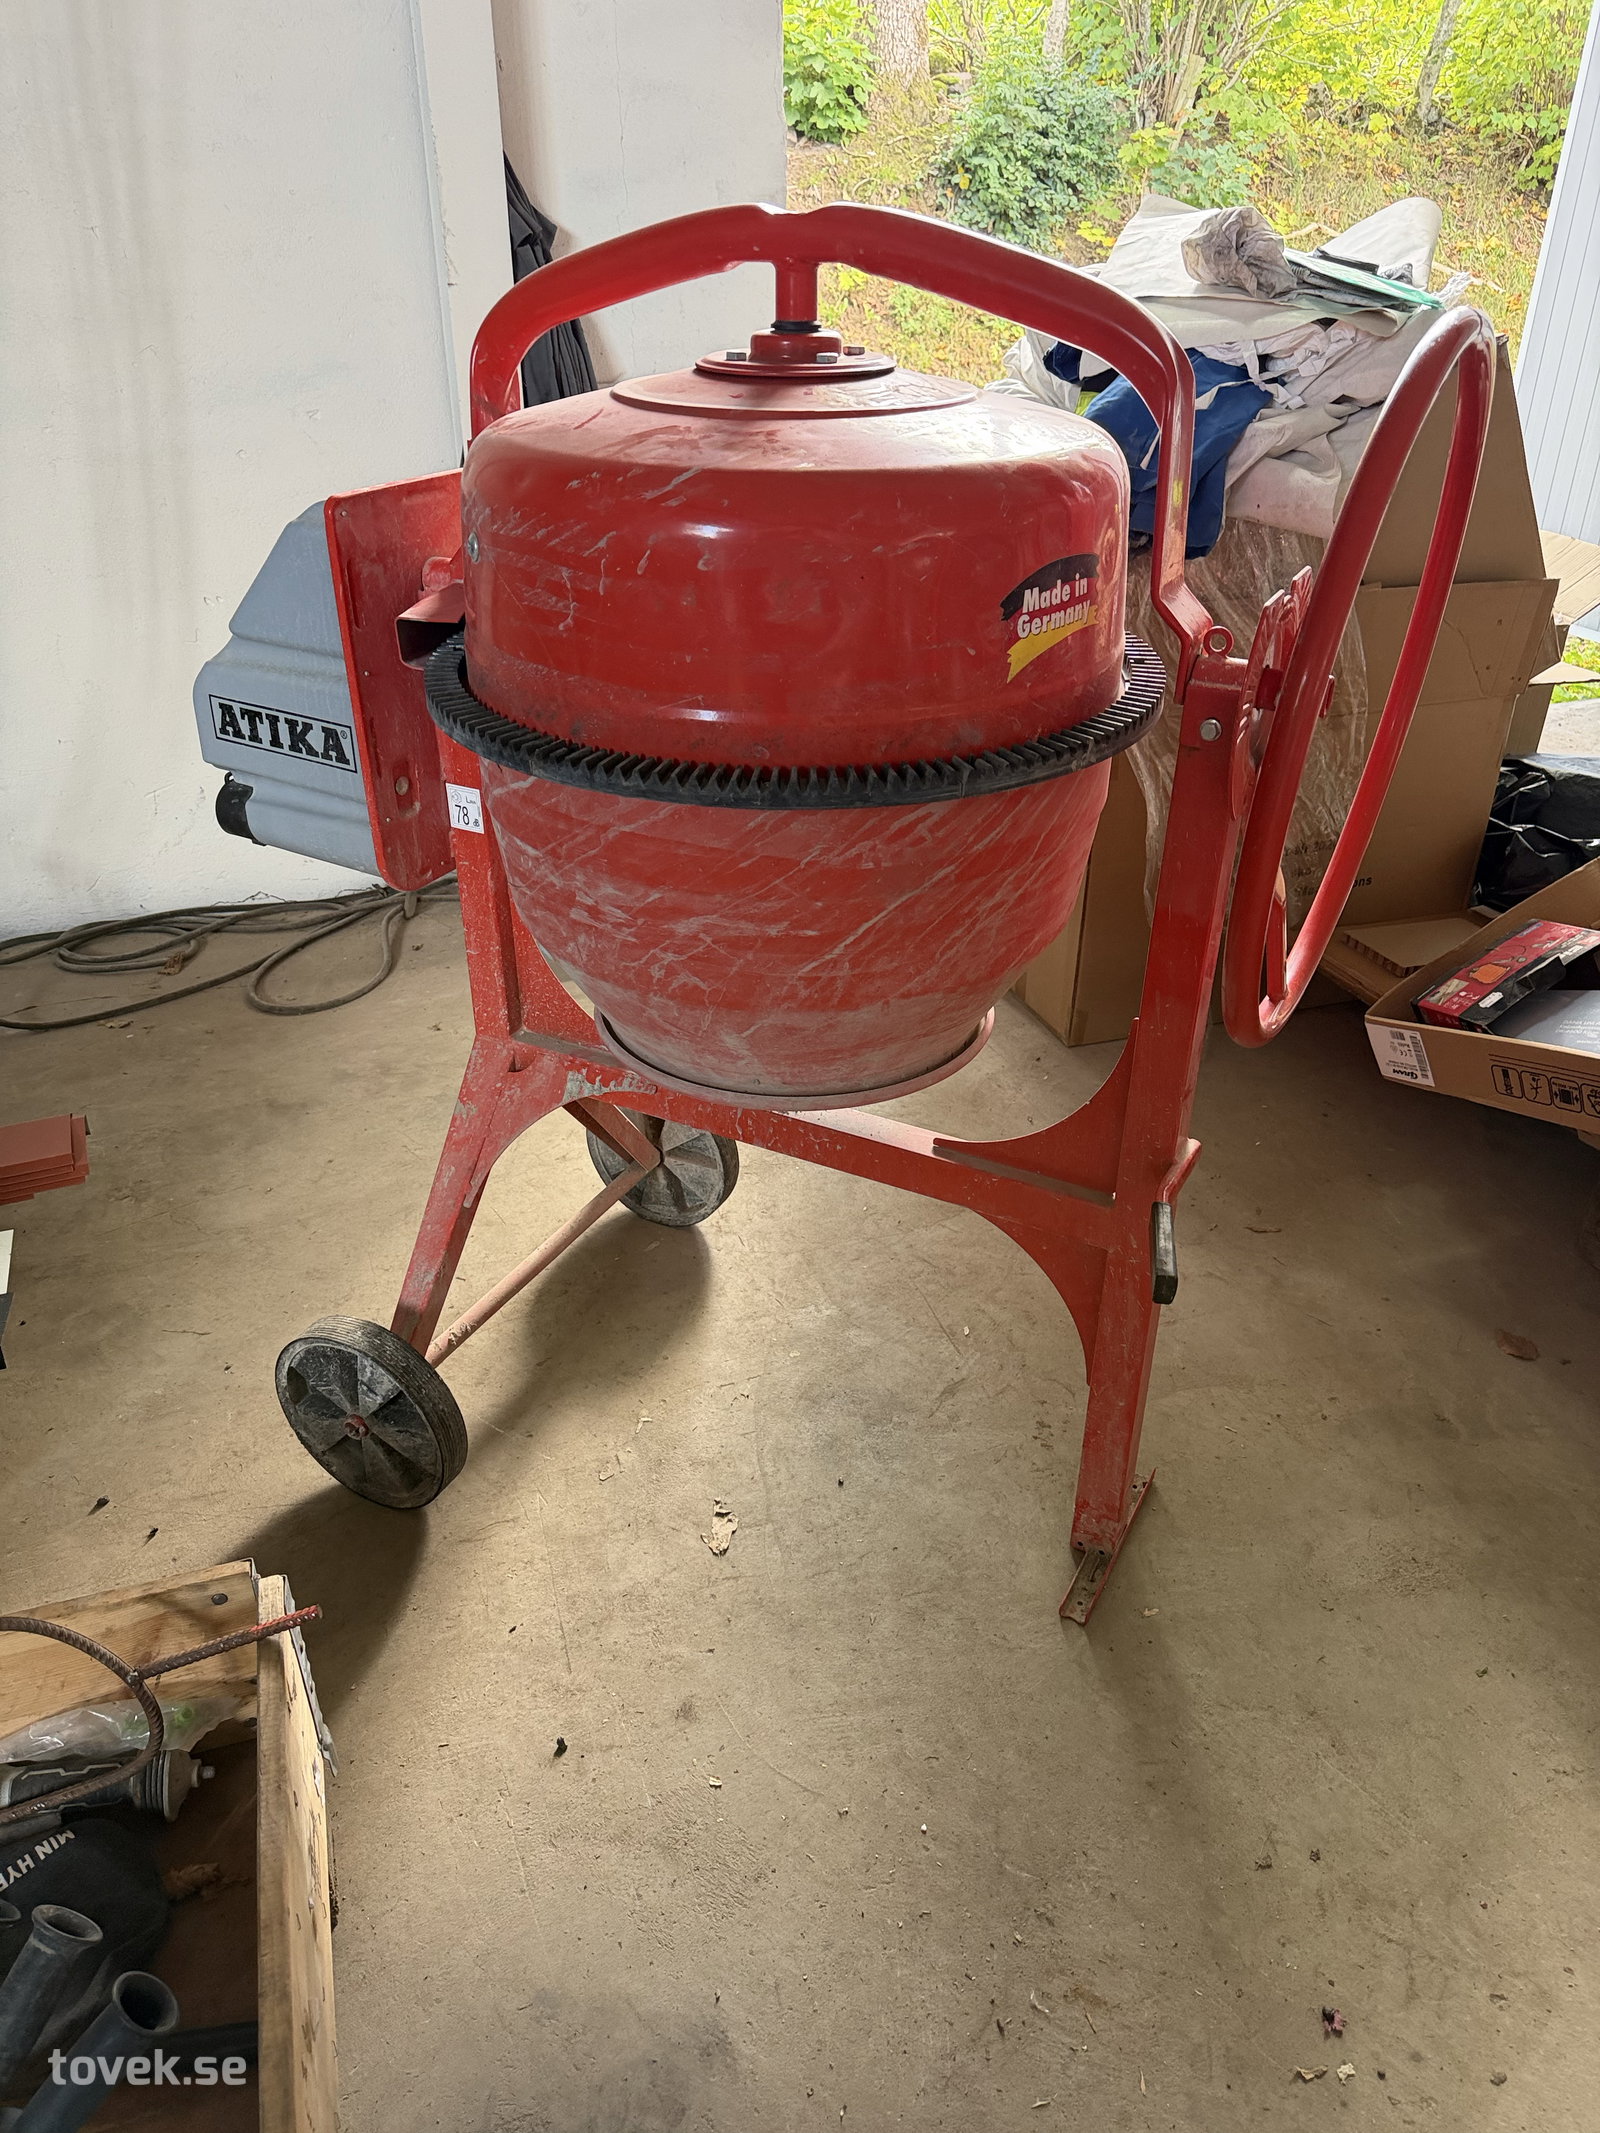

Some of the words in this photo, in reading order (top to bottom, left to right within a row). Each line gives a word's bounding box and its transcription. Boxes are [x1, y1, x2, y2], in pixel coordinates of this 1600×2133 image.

[1022, 579, 1070, 614] Made
[1075, 573, 1088, 597] in
[1017, 600, 1090, 639] Germany
[218, 702, 350, 766] ATIKA
[454, 804, 470, 826] 78
[34, 1830, 76, 1860] MIN
